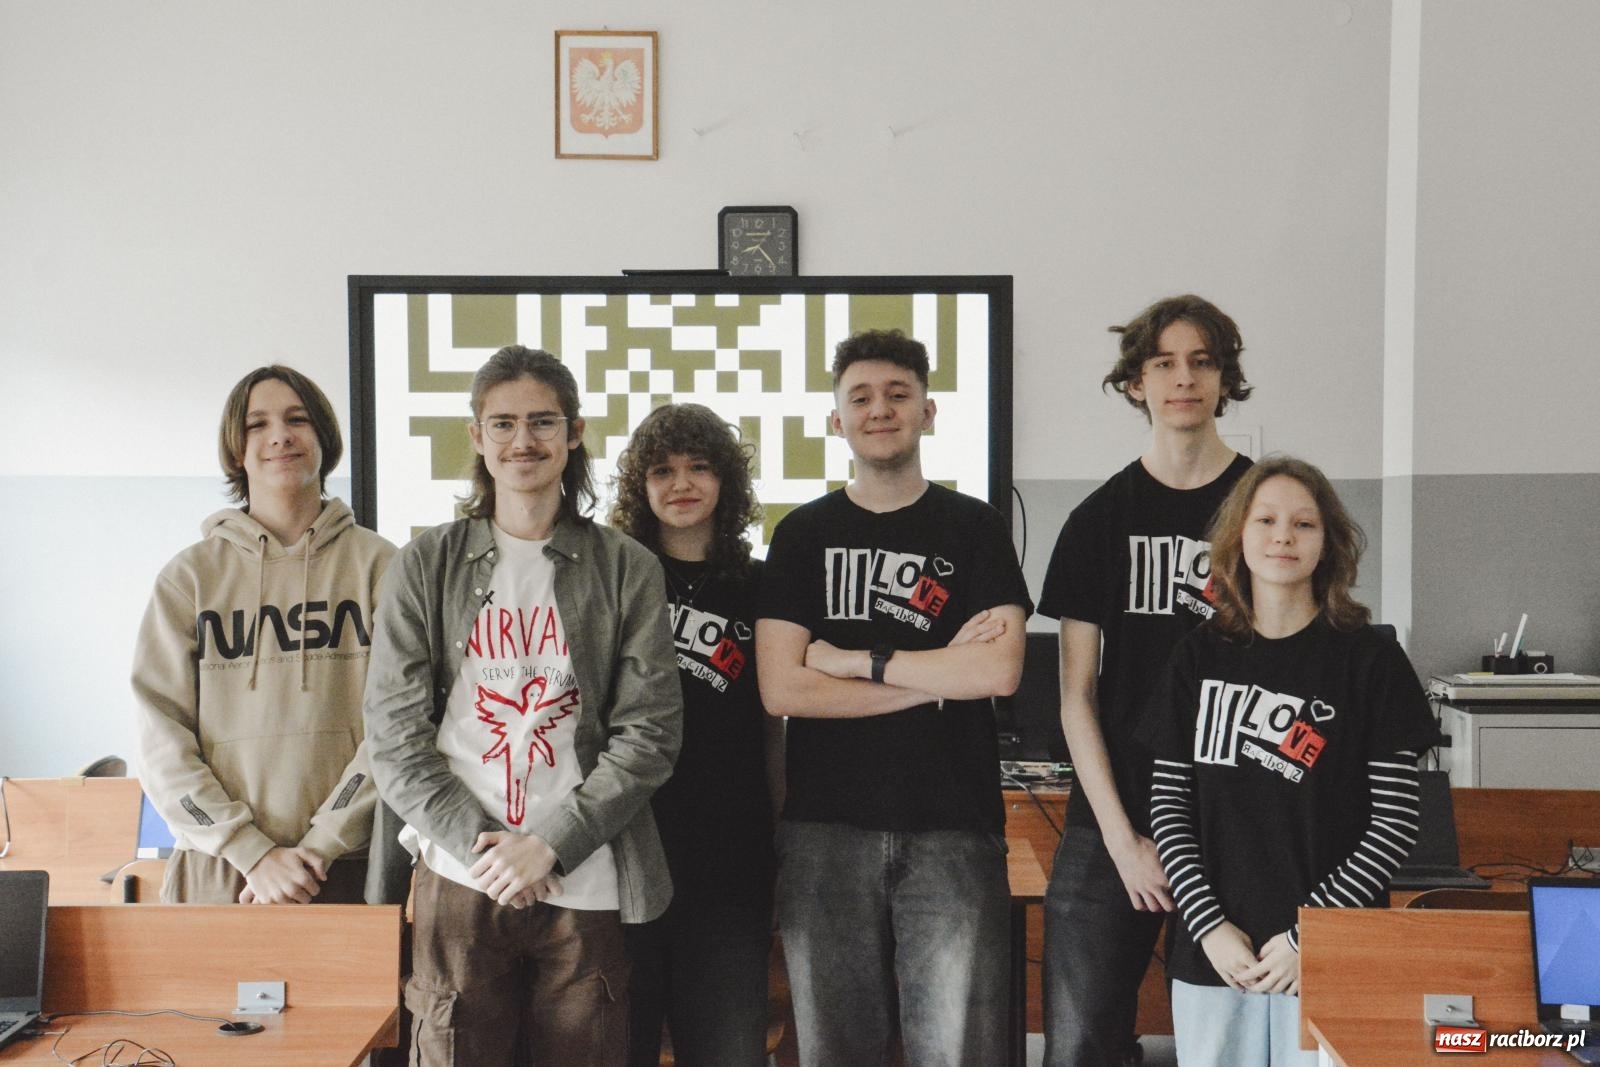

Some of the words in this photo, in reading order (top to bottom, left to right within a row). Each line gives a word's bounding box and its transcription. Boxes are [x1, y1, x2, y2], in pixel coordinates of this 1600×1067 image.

[197, 599, 371, 660] NASA
[482, 667, 516, 681] SERVE
[521, 665, 538, 679] THE
